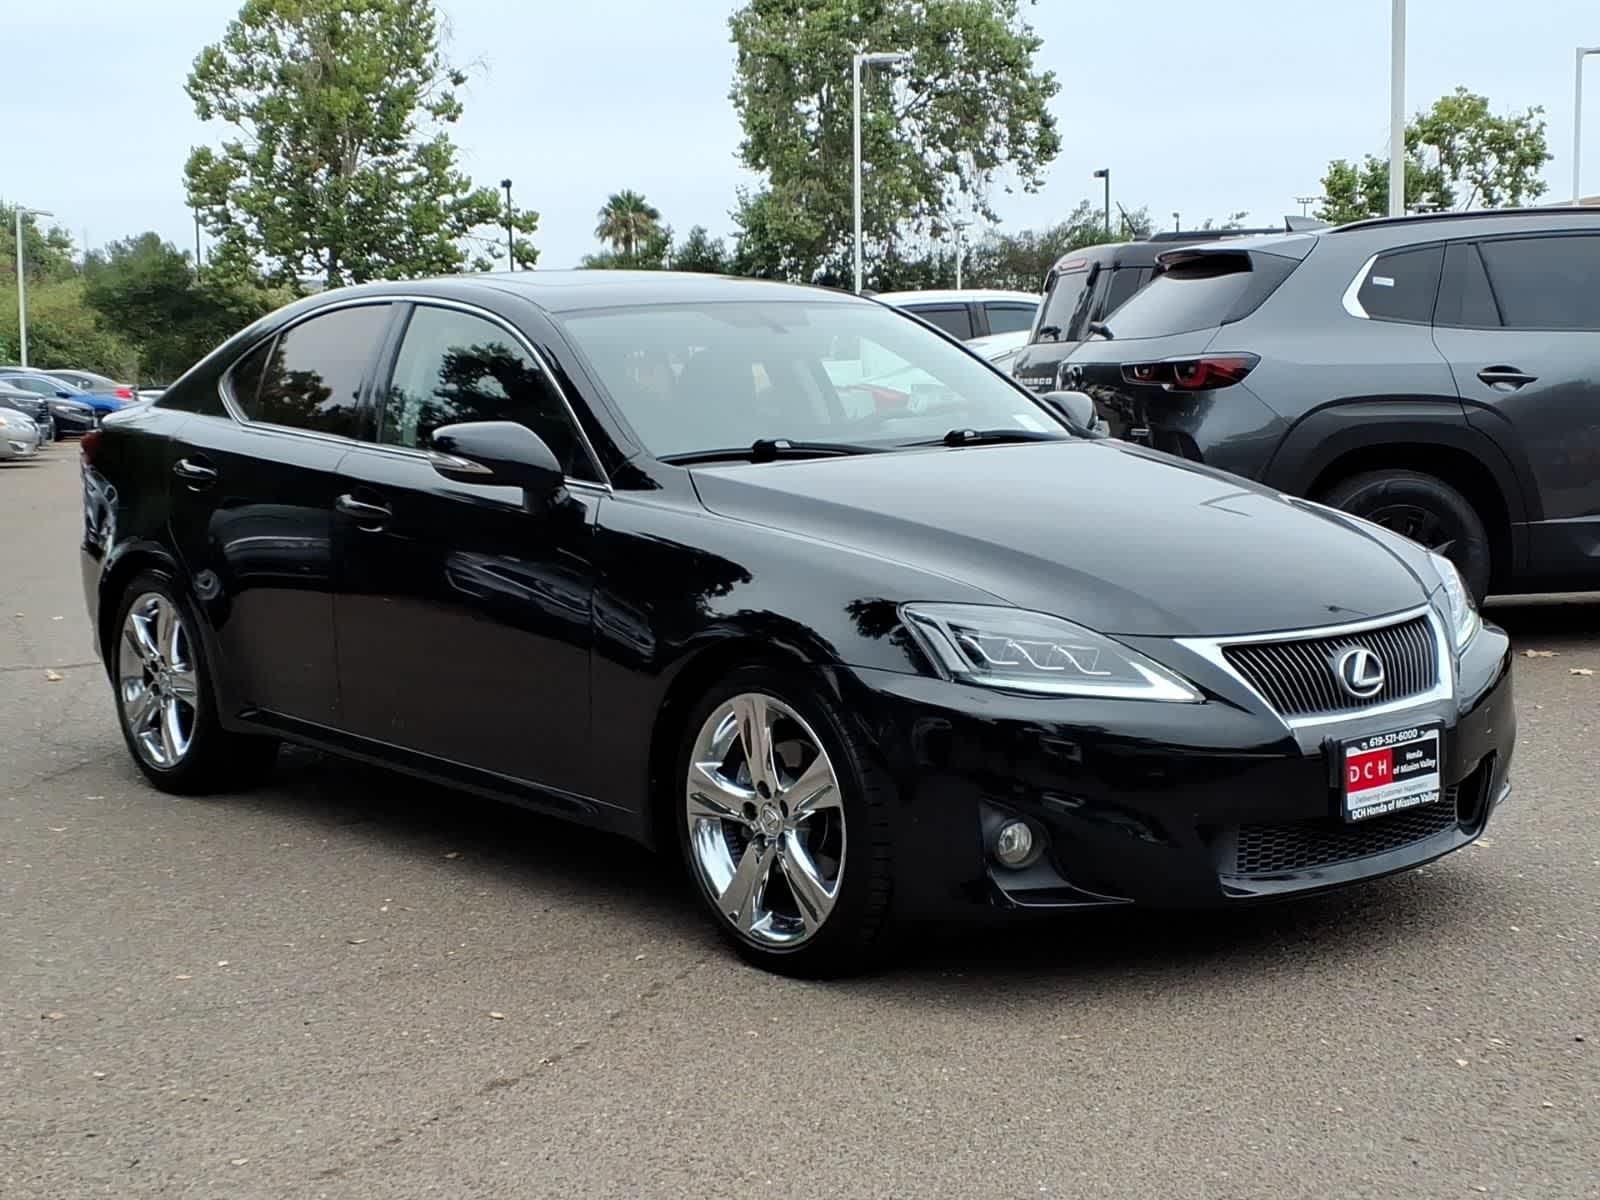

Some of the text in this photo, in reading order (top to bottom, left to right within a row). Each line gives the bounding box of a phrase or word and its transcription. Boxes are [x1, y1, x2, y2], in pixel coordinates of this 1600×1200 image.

[1392, 765, 1400, 775] of
[1420, 758, 1436, 768] Valley
[1352, 791, 1440, 820] DCH Honda of Mission Valley
